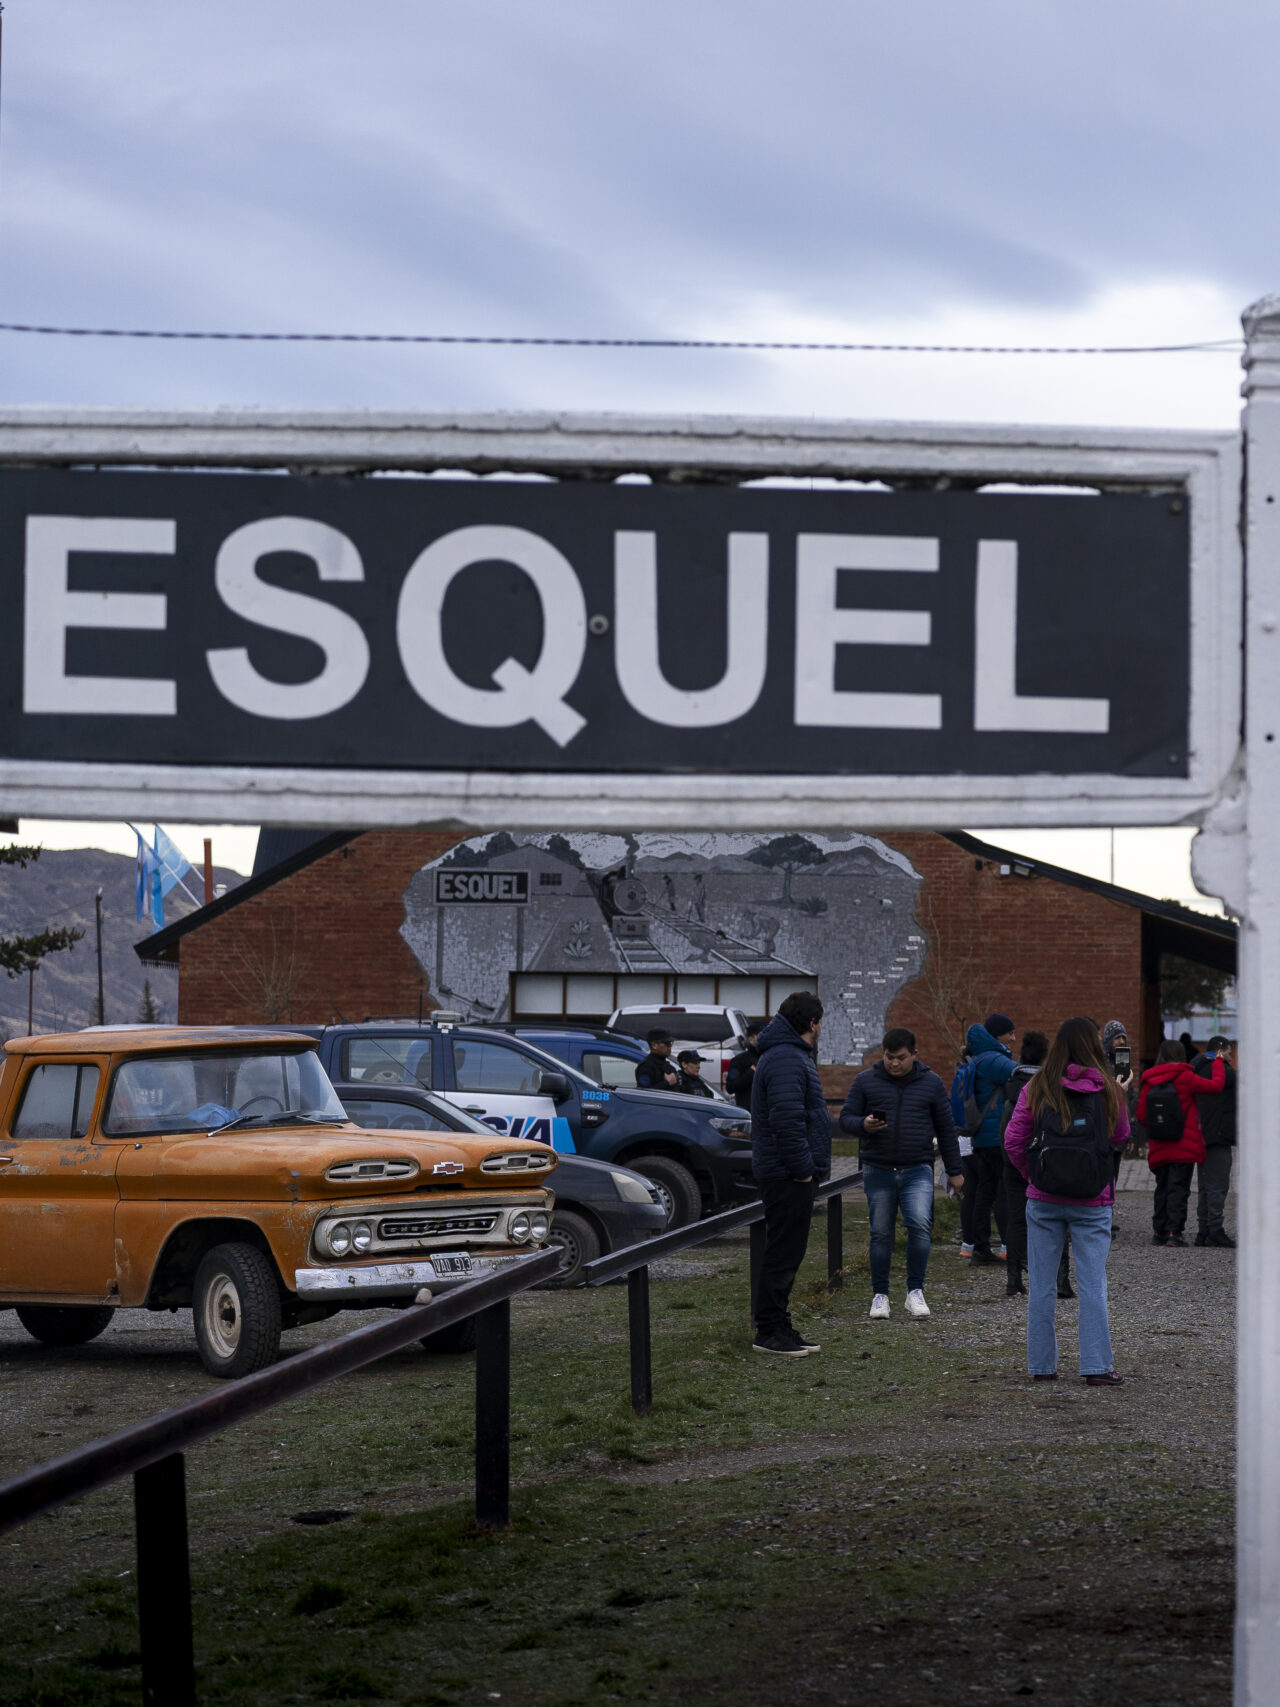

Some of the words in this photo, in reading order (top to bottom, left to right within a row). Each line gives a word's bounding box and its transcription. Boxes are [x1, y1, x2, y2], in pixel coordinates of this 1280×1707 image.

[23, 514, 1111, 748] ESQUEL
[439, 873, 526, 900] ESQUEL
[582, 1090, 610, 1101] 8038
[434, 1258, 453, 1273] VAD
[455, 1257, 472, 1272] 913
